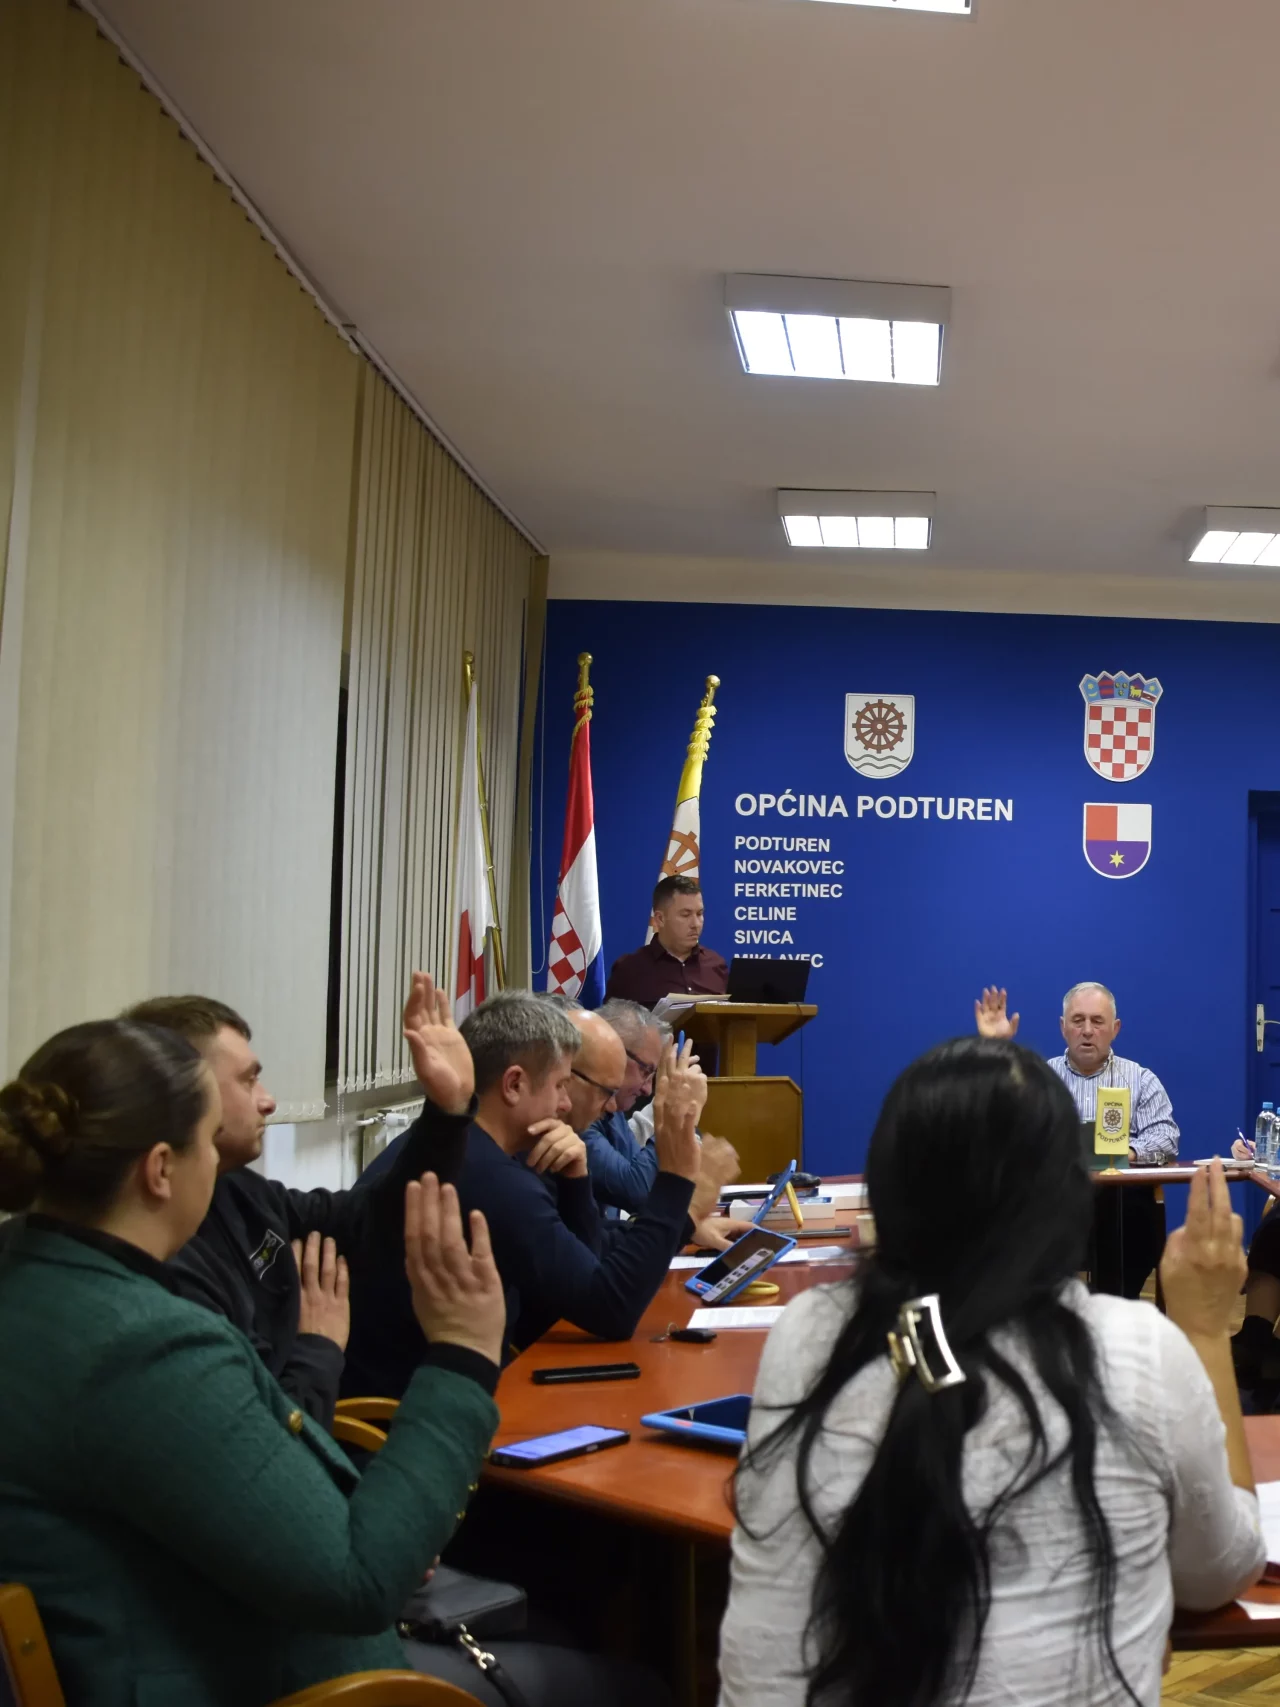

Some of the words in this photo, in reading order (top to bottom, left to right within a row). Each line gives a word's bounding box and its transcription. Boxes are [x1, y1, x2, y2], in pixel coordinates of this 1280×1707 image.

[735, 789, 849, 818] OPĆINA
[857, 795, 1014, 821] PODTUREN
[734, 836, 831, 853] PODTUREN
[734, 859, 845, 875] NOVAKOVEC
[734, 883, 843, 898] FERKETINEC
[734, 906, 797, 921] CELINE
[734, 930, 794, 945] SIVICA
[1097, 1132, 1127, 1143] PODTUREN
